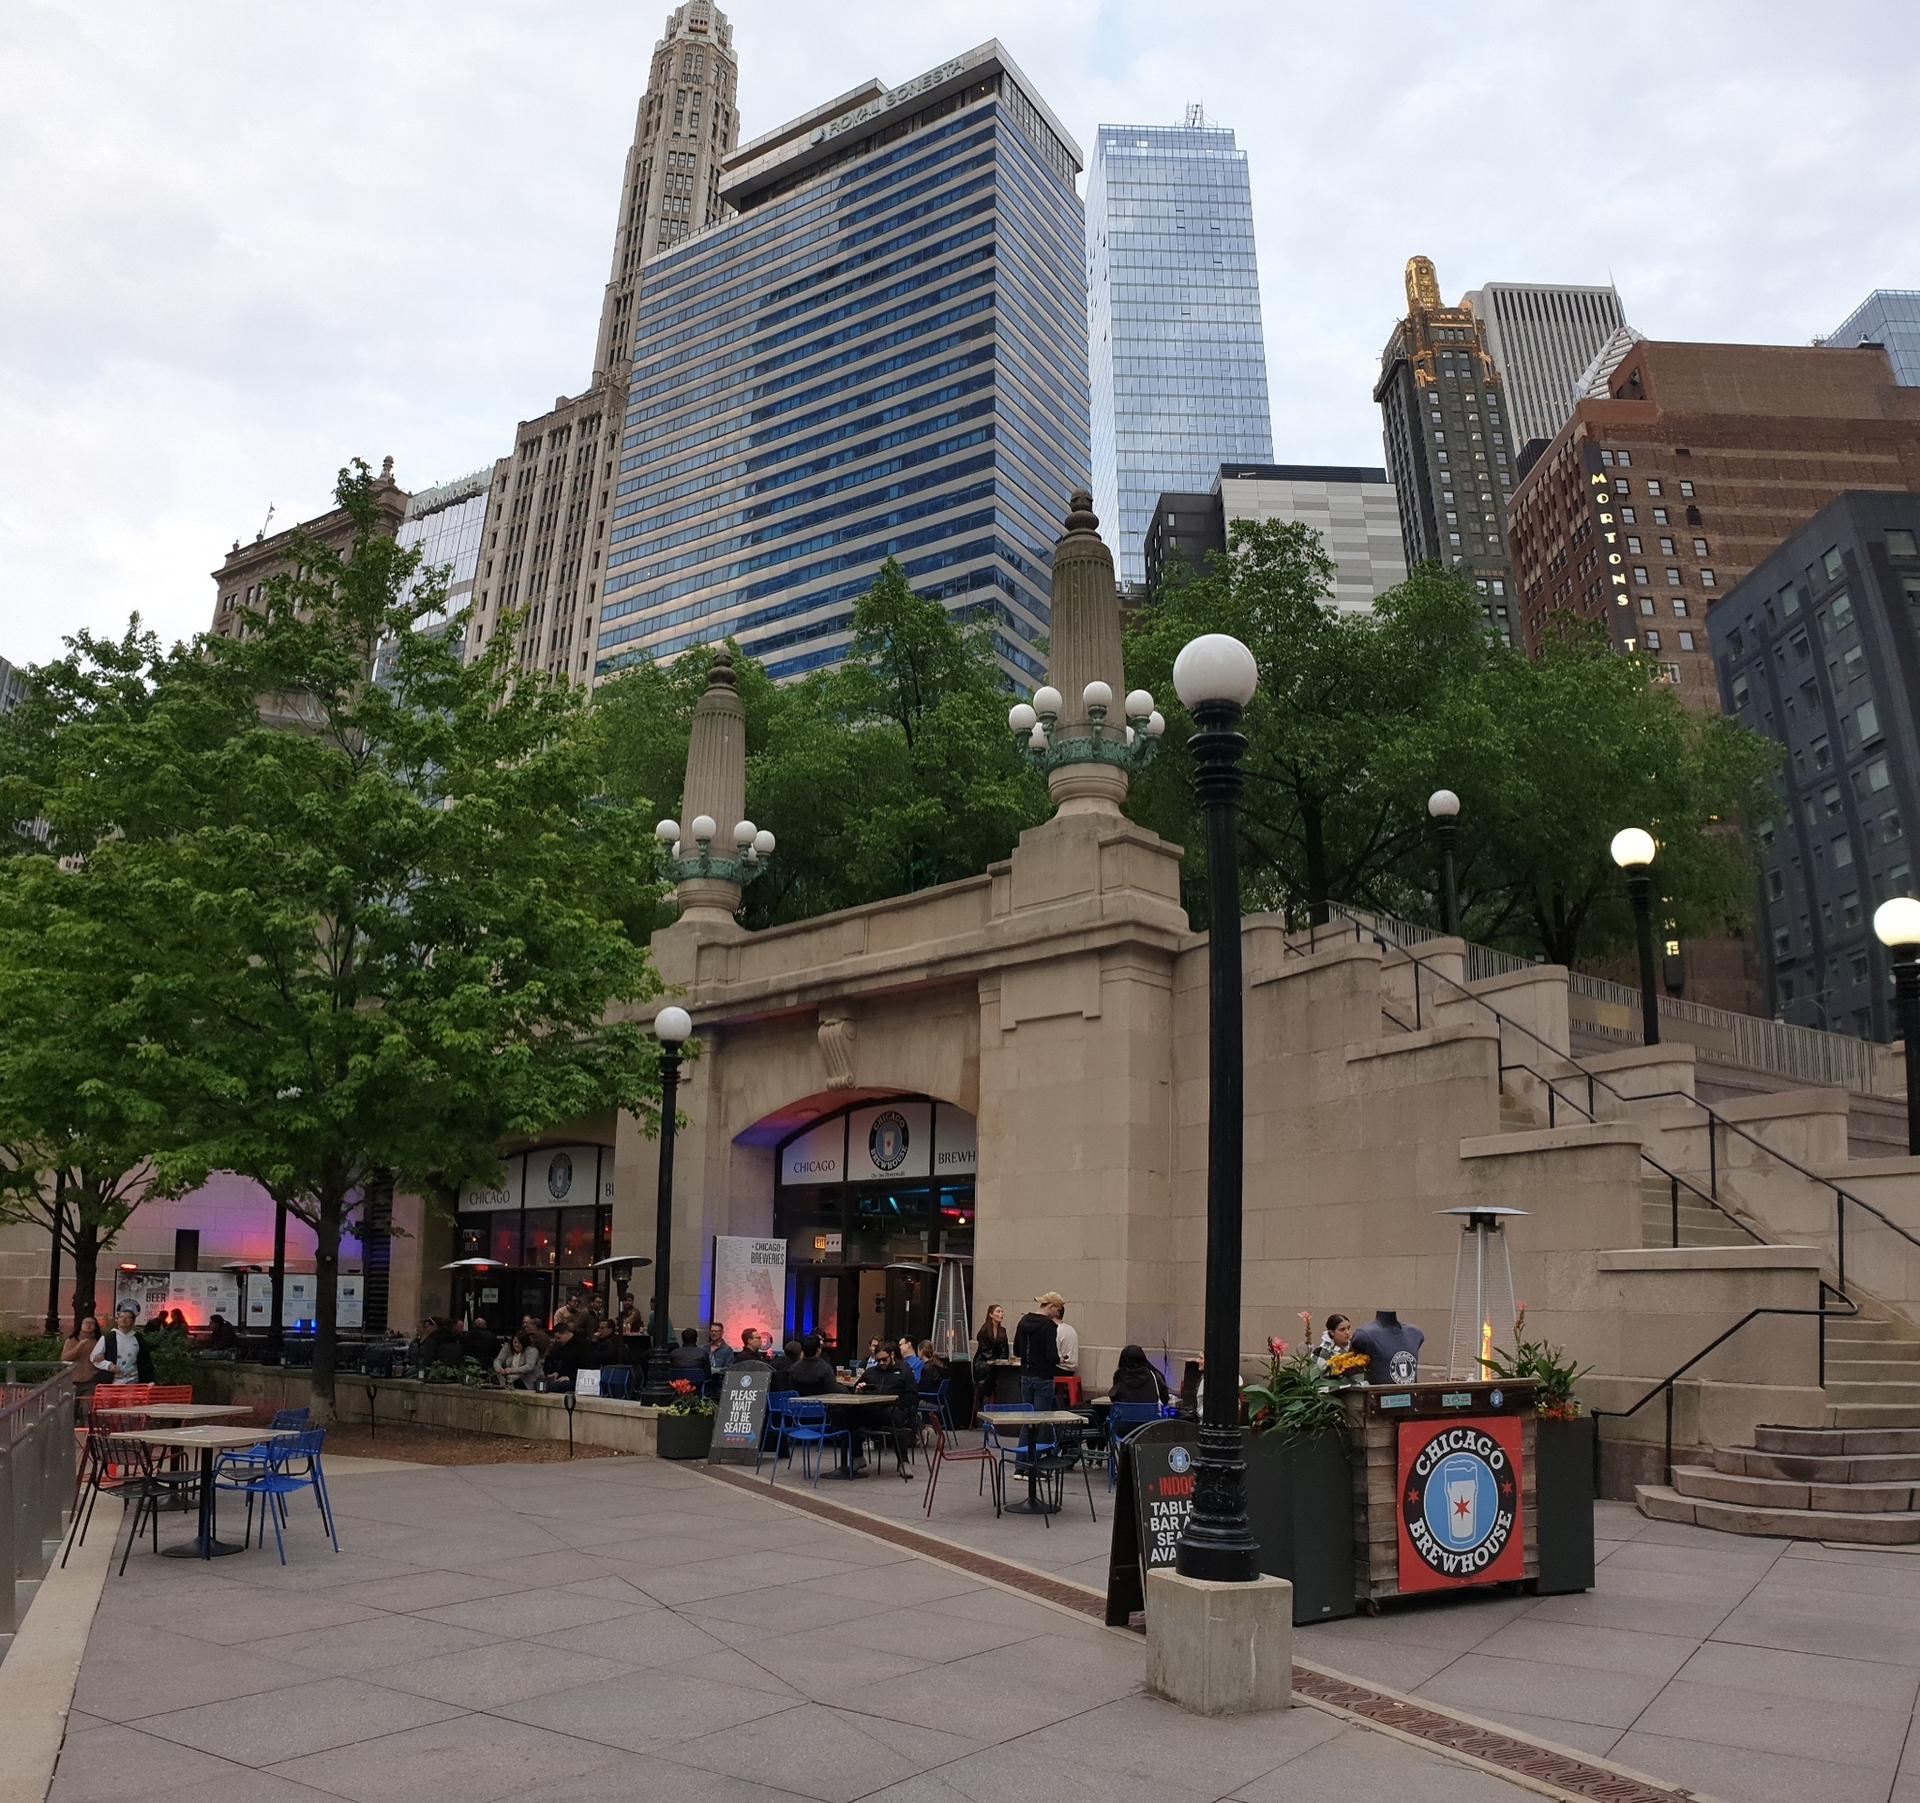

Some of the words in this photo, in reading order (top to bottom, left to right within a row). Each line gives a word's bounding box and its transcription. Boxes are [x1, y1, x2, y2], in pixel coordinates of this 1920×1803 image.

[829, 101, 881, 137] ROYAL
[885, 60, 965, 107] SONESTA
[1591, 473, 1629, 606] MORTONS
[793, 1159, 836, 1173] CHICAGO
[469, 1190, 511, 1206] CHICAGO
[755, 1242, 781, 1252] CHICAGO
[750, 1252, 785, 1265] BREWERIES
[146, 1293, 166, 1303] BEER
[730, 1390, 758, 1401] PLEASE
[732, 1401, 752, 1411] WAIT
[730, 1411, 740, 1422] TO
[740, 1412, 751, 1422] BE
[723, 1422, 752, 1434] SEATED
[1415, 1429, 1505, 1477] CHICAGO
[1150, 1516, 1180, 1531] BAR
[1409, 1510, 1513, 1574] BREWHOUSE
